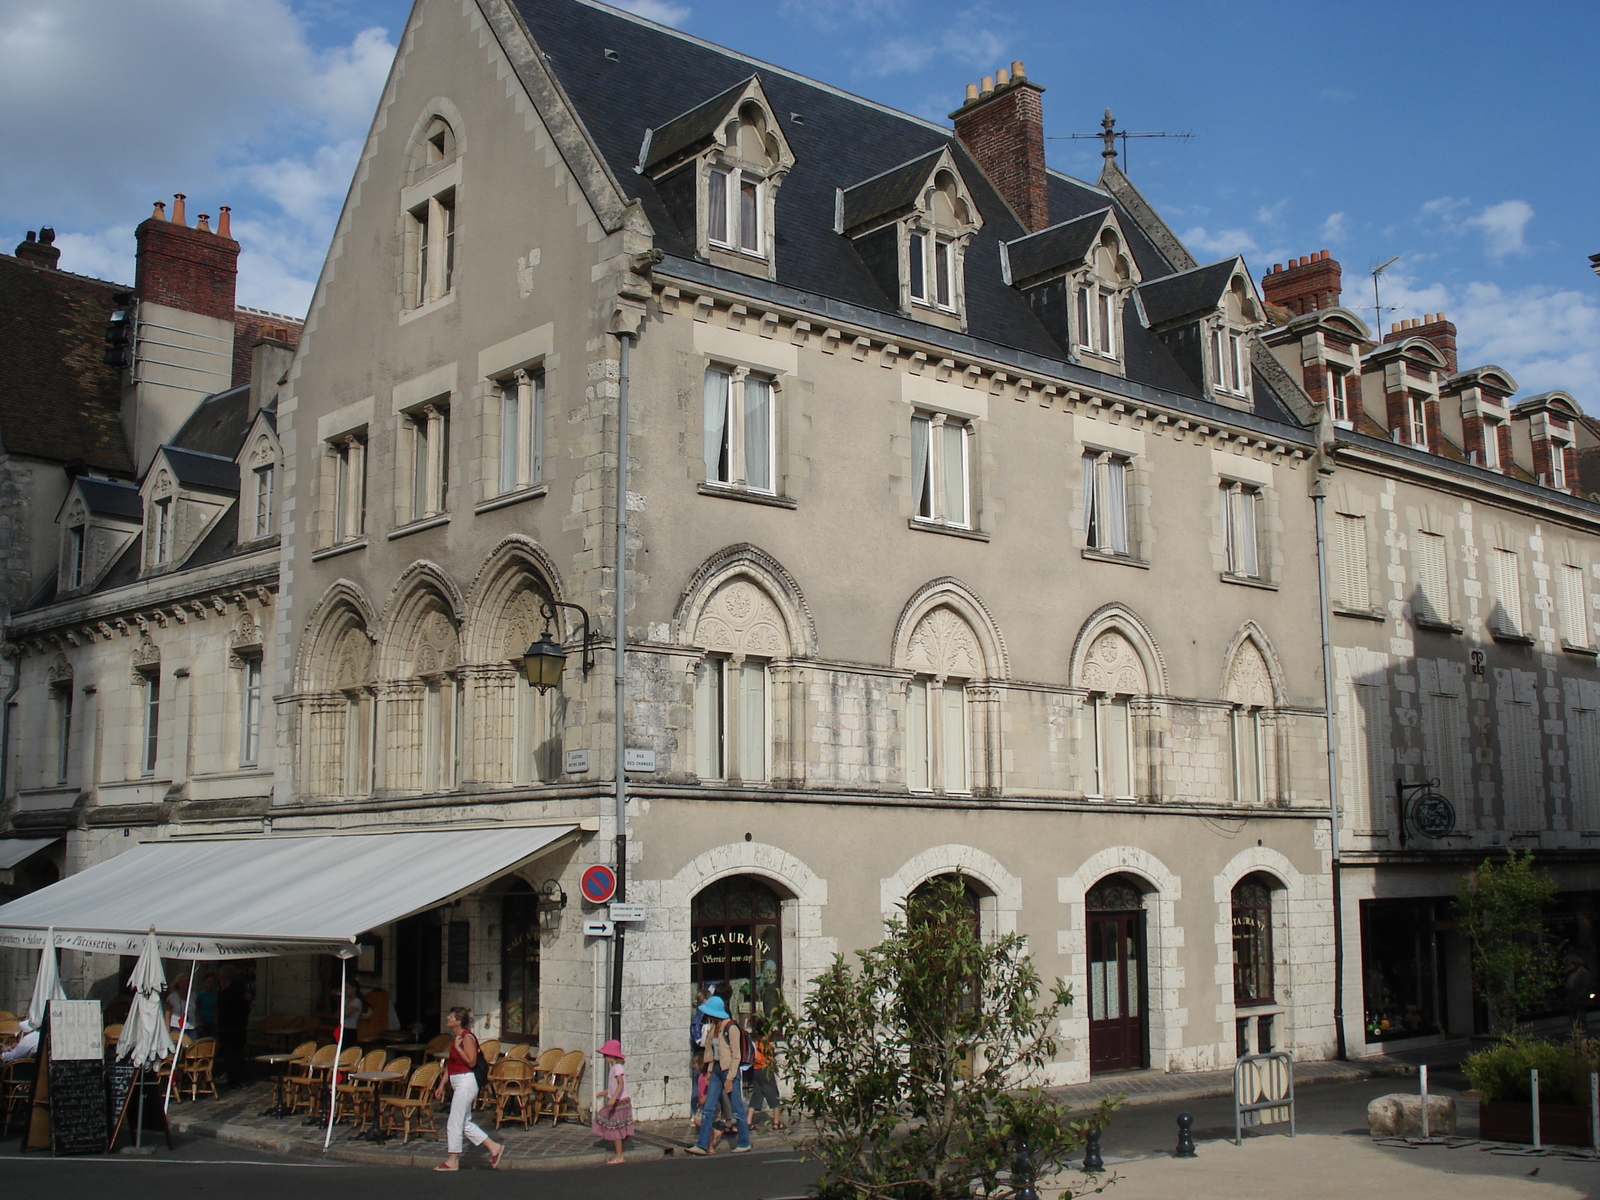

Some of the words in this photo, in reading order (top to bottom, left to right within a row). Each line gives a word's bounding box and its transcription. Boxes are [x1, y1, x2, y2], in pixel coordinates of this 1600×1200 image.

[72, 935, 117, 951] Pâtisseries
[215, 943, 270, 955] Brasserie
[690, 932, 771, 956] ESTAURANT
